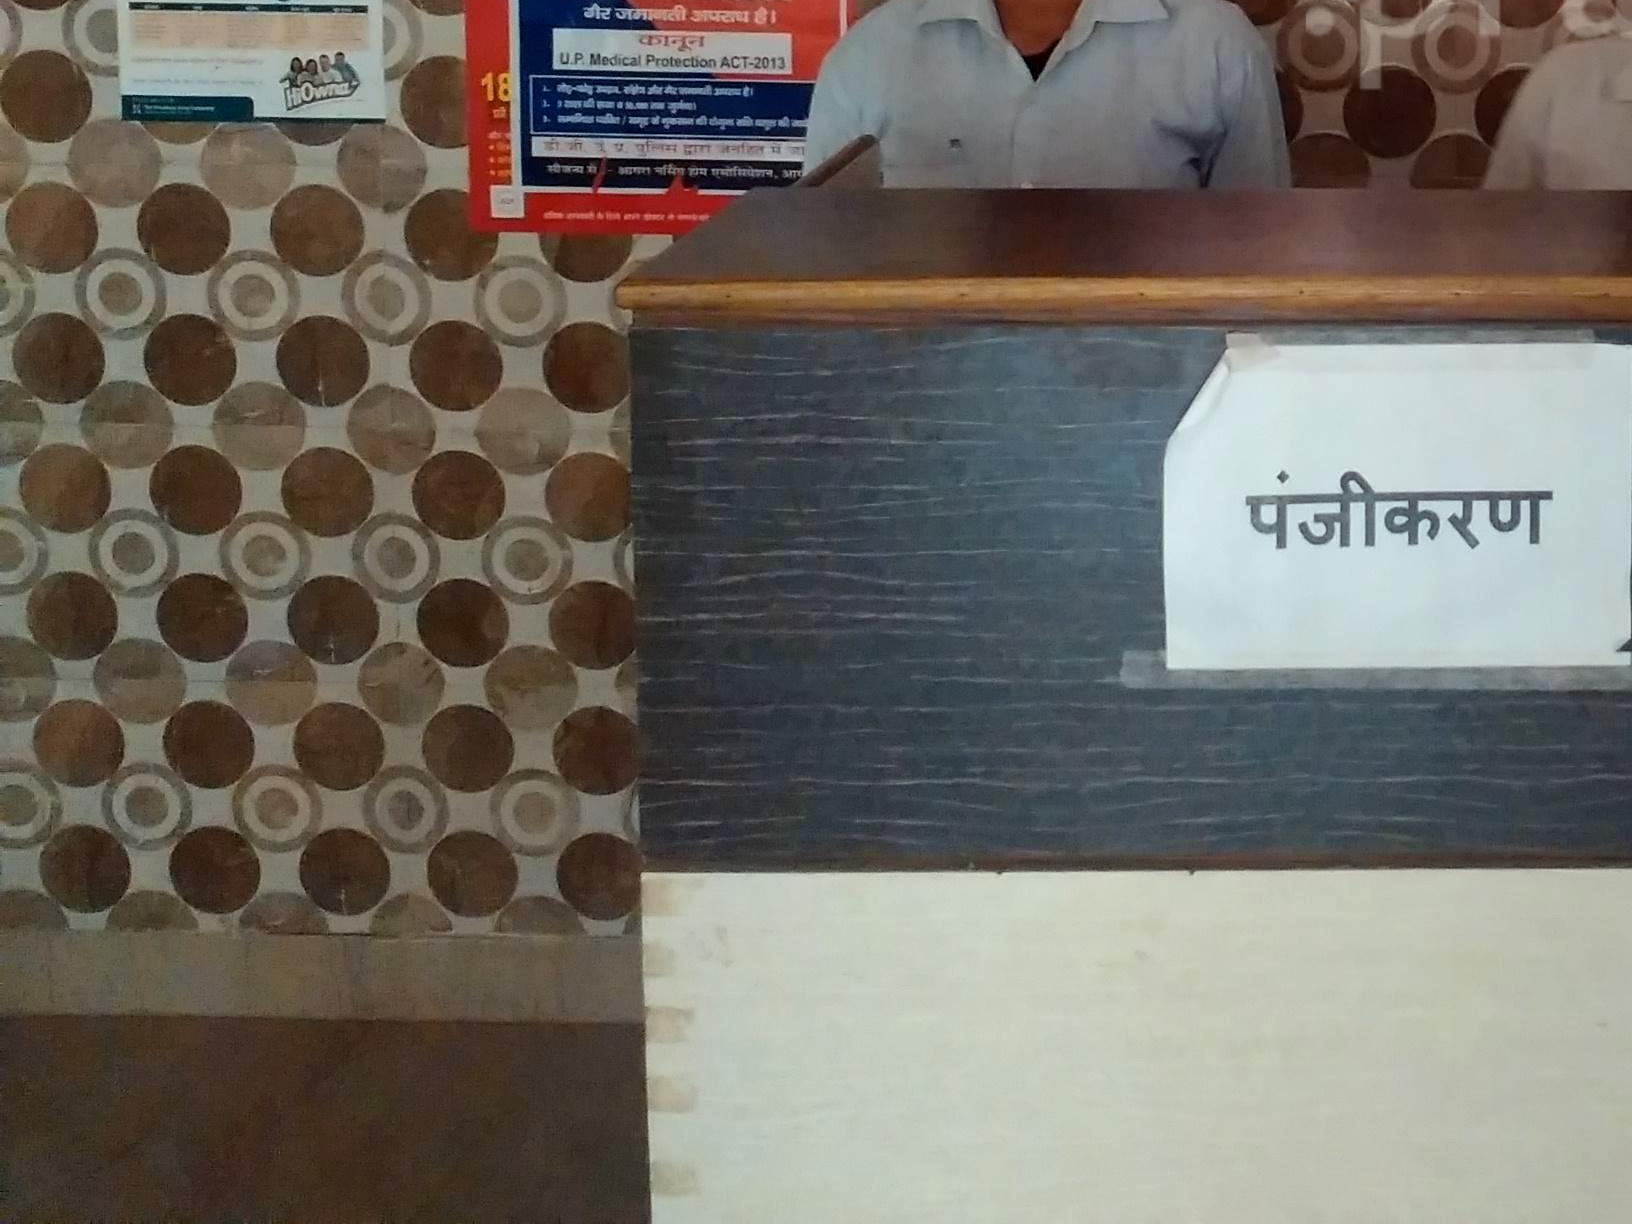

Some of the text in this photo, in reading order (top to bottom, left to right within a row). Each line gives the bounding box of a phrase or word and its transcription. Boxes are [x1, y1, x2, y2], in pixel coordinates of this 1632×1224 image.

[583, 4, 613, 22] गैर
[615, 4, 688, 23] जमानती
[690, 8, 749, 25] अपराध
[638, 32, 706, 53] कानून
[559, 52, 787, 71] U.P. Medical Protection ACT-2013
[617, 165, 651, 177] आगरा
[1246, 470, 1553, 549] पंजीकरण
